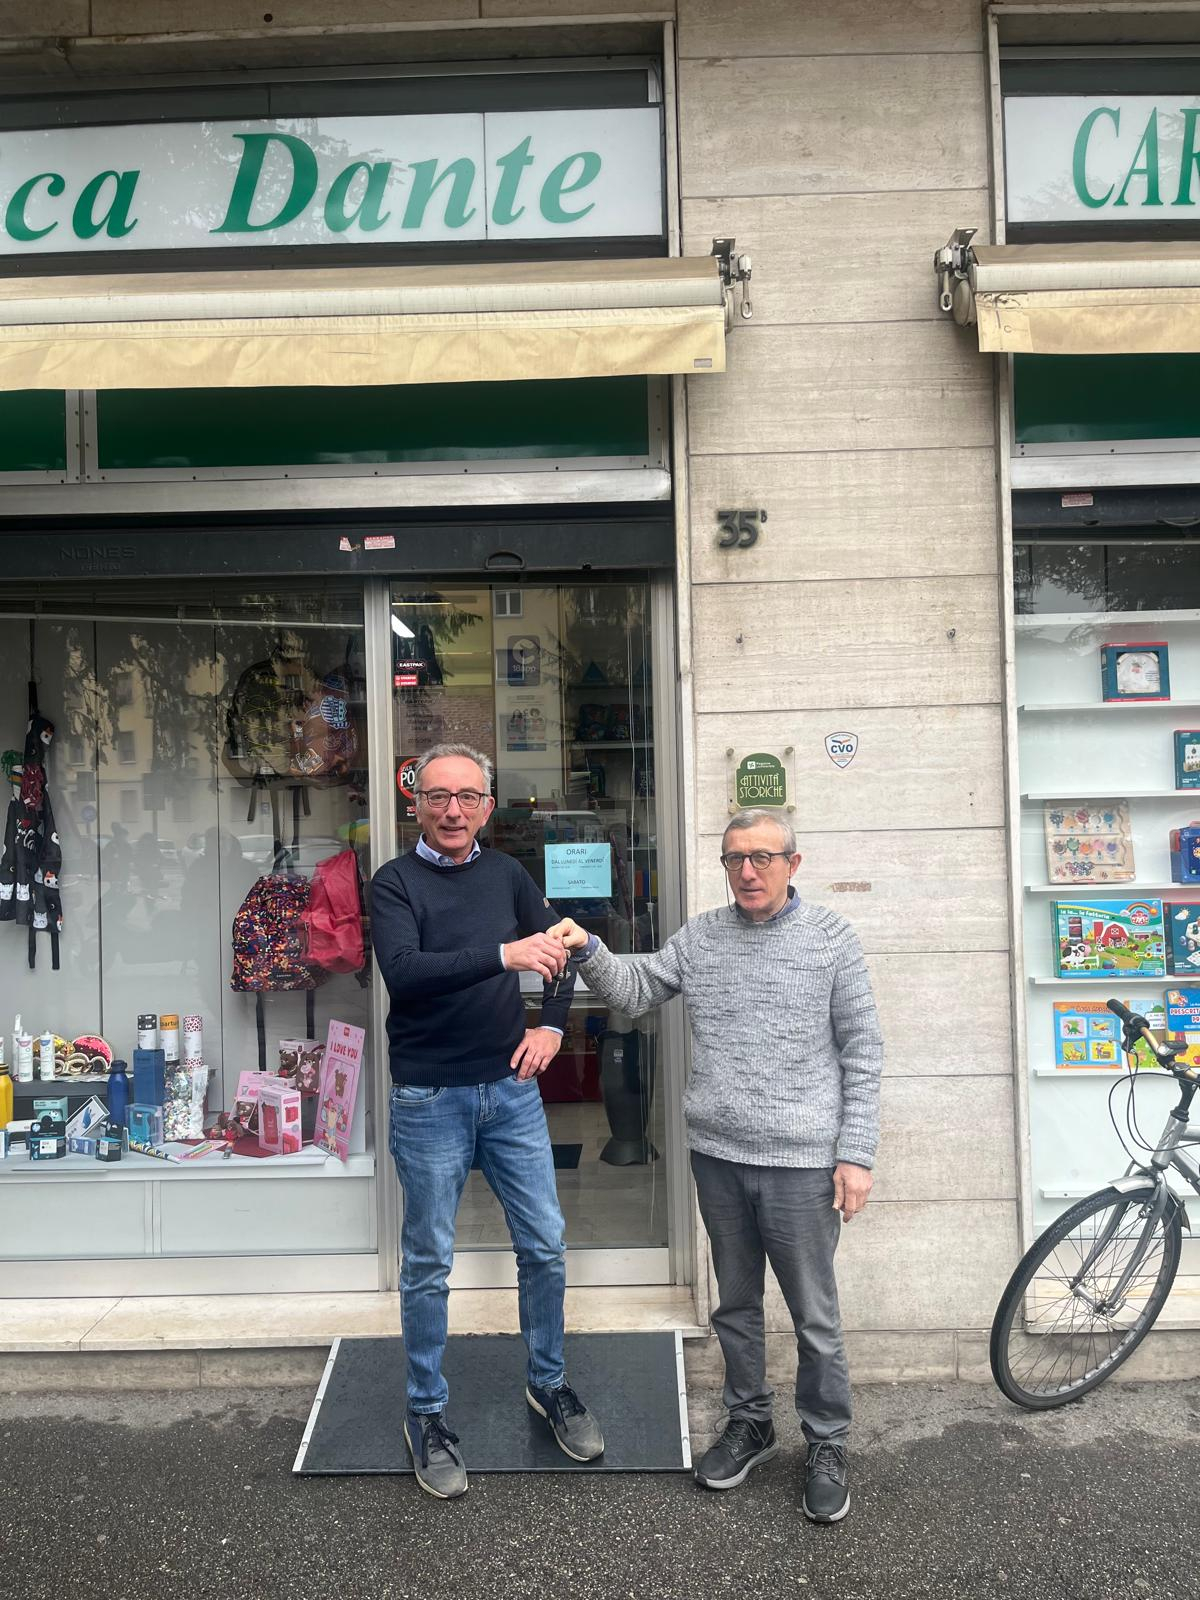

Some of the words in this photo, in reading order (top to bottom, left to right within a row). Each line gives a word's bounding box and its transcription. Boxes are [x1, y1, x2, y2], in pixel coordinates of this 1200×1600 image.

[4, 169, 141, 242] ca
[210, 132, 602, 234] Dante
[830, 744, 854, 754] CVO
[740, 773, 780, 787] ATTIVITÀ
[739, 786, 784, 799] STORICHE
[566, 848, 587, 856] ORARI
[334, 1042, 347, 1056] LOVE
[347, 1045, 359, 1060] YOU
